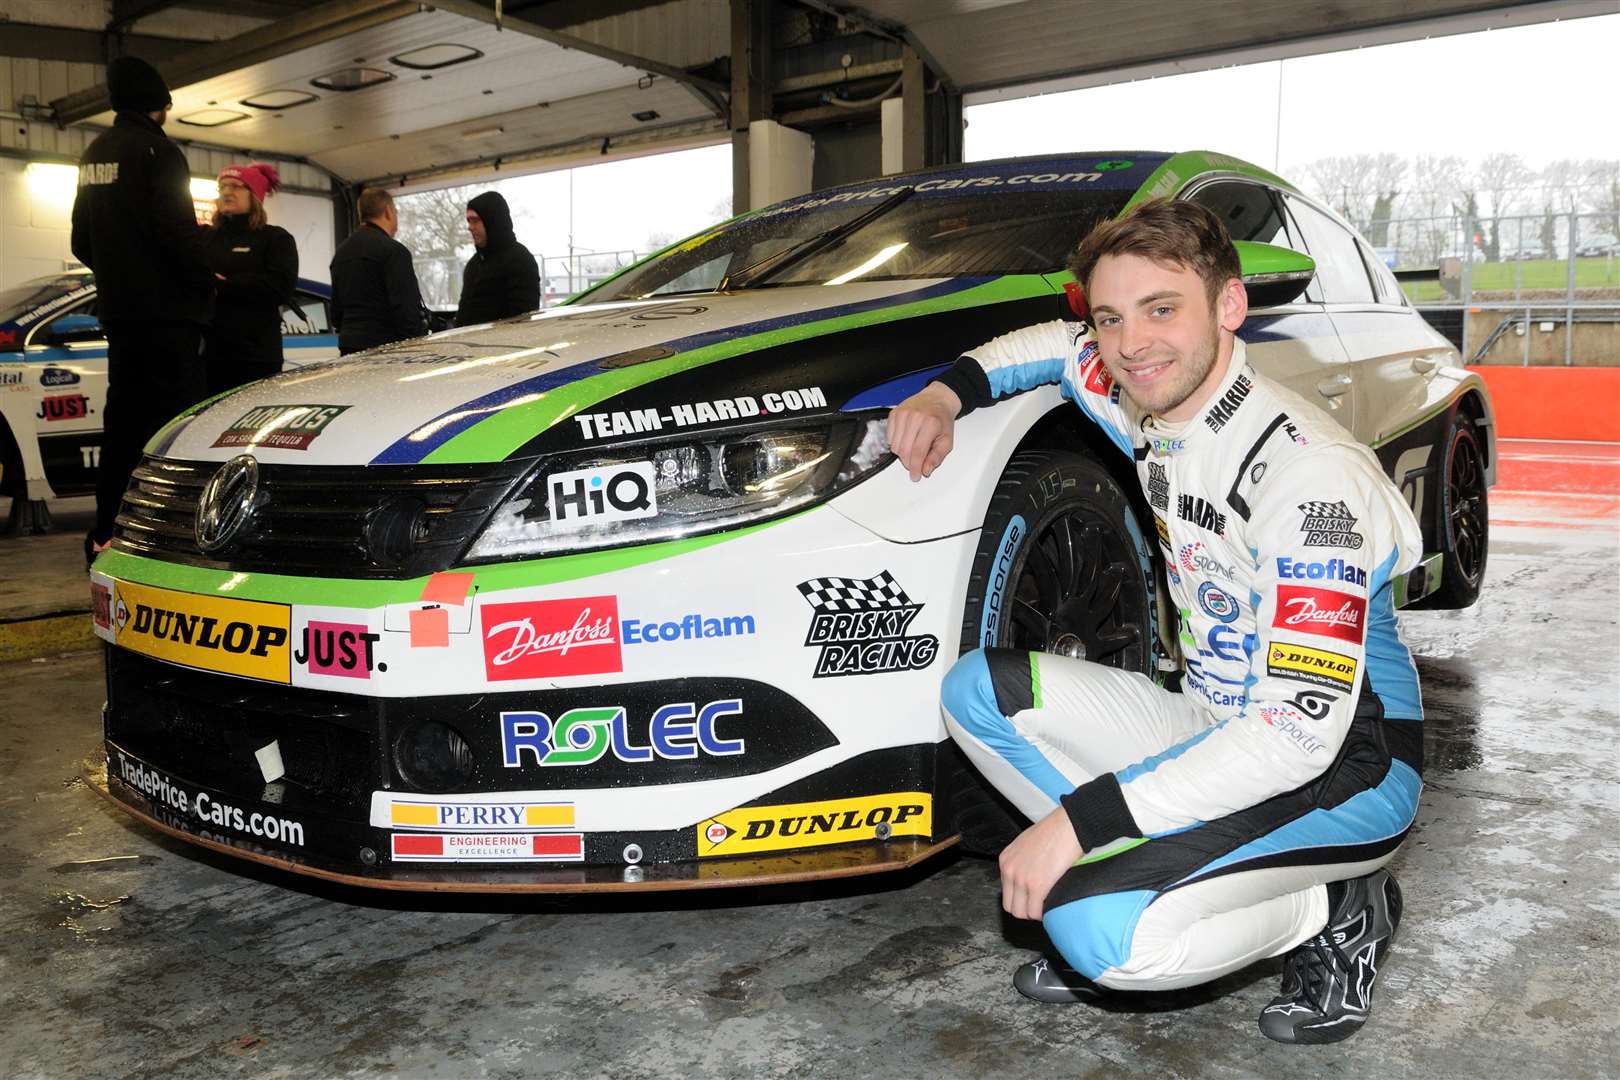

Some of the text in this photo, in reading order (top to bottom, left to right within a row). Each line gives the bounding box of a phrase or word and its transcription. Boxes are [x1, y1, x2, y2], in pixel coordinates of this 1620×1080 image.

[36, 396, 95, 419] JUST.
[232, 407, 339, 430] AMOS
[574, 387, 828, 440] TEAM-HARD.COM
[553, 471, 651, 520] HiQ
[1305, 518, 1356, 532] BRISKY
[1308, 531, 1363, 549] RACING
[1276, 557, 1366, 588] Ecoflam
[622, 612, 755, 645] Ecoflam
[809, 608, 917, 644] BRISKY
[1285, 597, 1358, 627] Danfoss
[132, 604, 287, 658] DUNLOP
[487, 607, 616, 666] Danfoss
[294, 627, 389, 673] JUST.
[818, 637, 935, 675] RACING
[1287, 653, 1353, 674] DUNLOP
[501, 698, 744, 768] ROLEC
[440, 806, 525, 825] PERRY
[741, 804, 925, 841] DUNLOP
[449, 836, 527, 846] ENGINEERING
